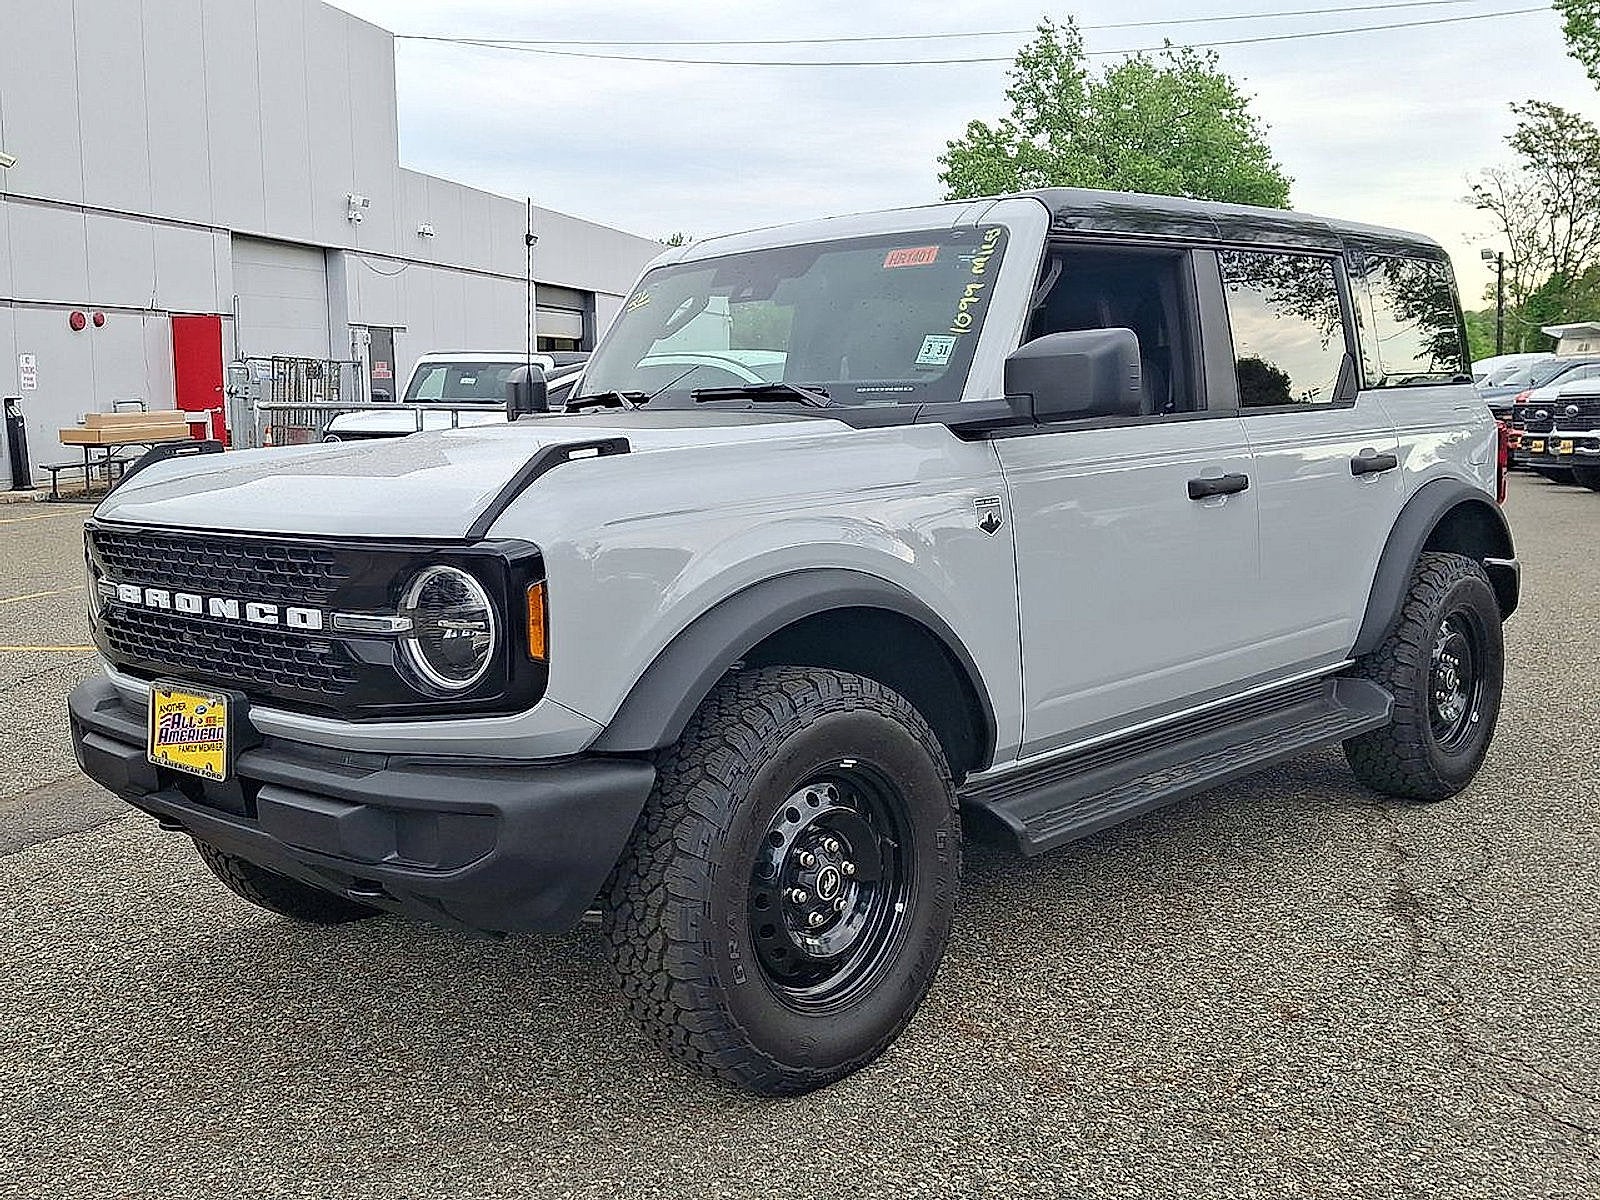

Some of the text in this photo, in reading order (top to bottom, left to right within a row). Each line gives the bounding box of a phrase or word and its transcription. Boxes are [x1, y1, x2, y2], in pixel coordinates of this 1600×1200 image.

[924, 343, 949, 356] 3 31
[116, 584, 322, 630] BRONCO
[159, 702, 187, 714] ANOTHER
[178, 742, 224, 753] FAMILY MEMBER
[201, 769, 223, 780] FORD
